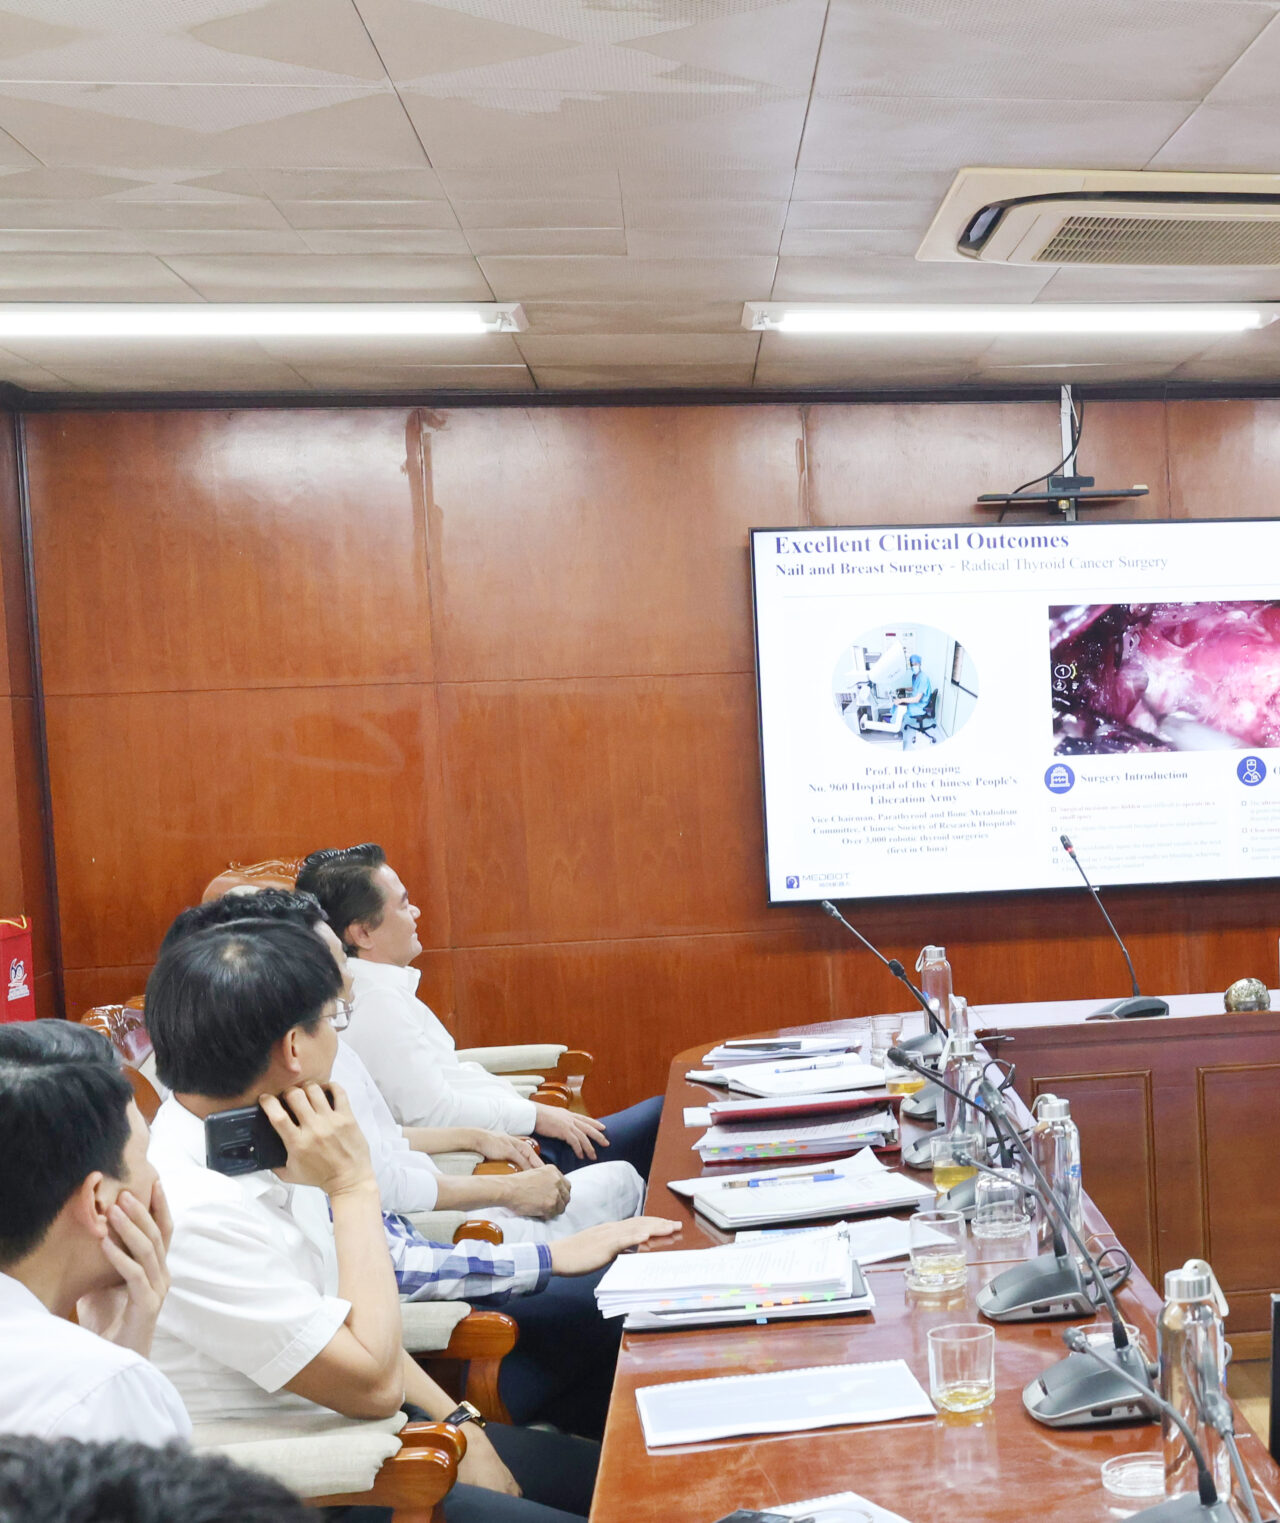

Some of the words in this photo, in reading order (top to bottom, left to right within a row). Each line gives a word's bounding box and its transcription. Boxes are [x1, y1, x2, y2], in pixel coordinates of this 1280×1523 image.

[775, 535, 871, 555] Excellent
[879, 533, 959, 553] Clinical
[966, 531, 1070, 551] Outcomes
[775, 563, 804, 577] Nail
[809, 563, 836, 576] and
[840, 562, 885, 576] Breast
[889, 560, 945, 577] Surgery
[960, 557, 1010, 573] Radical
[1015, 556, 1065, 574] Thyroid
[1069, 556, 1115, 571] Cancer
[1119, 554, 1168, 572] Surgery
[864, 766, 891, 776] Prof.
[894, 765, 909, 775] He
[912, 763, 961, 775] Qingqing
[1080, 773, 1121, 784] Surgery
[1125, 770, 1188, 780] Introduction
[808, 783, 826, 792] No.
[829, 782, 848, 791] 960
[851, 780, 895, 792] Hospital
[898, 779, 908, 789] of
[911, 779, 928, 788] the
[930, 778, 972, 788] Chinese
[869, 794, 926, 805] Liberation
[929, 793, 959, 804] Army
[810, 815, 828, 823] Vice
[929, 810, 944, 818] and
[863, 825, 894, 833] Chinese
[897, 823, 926, 832] Society
[929, 822, 937, 830] of
[939, 821, 976, 829] Research
[978, 819, 1017, 829] Hospitals
